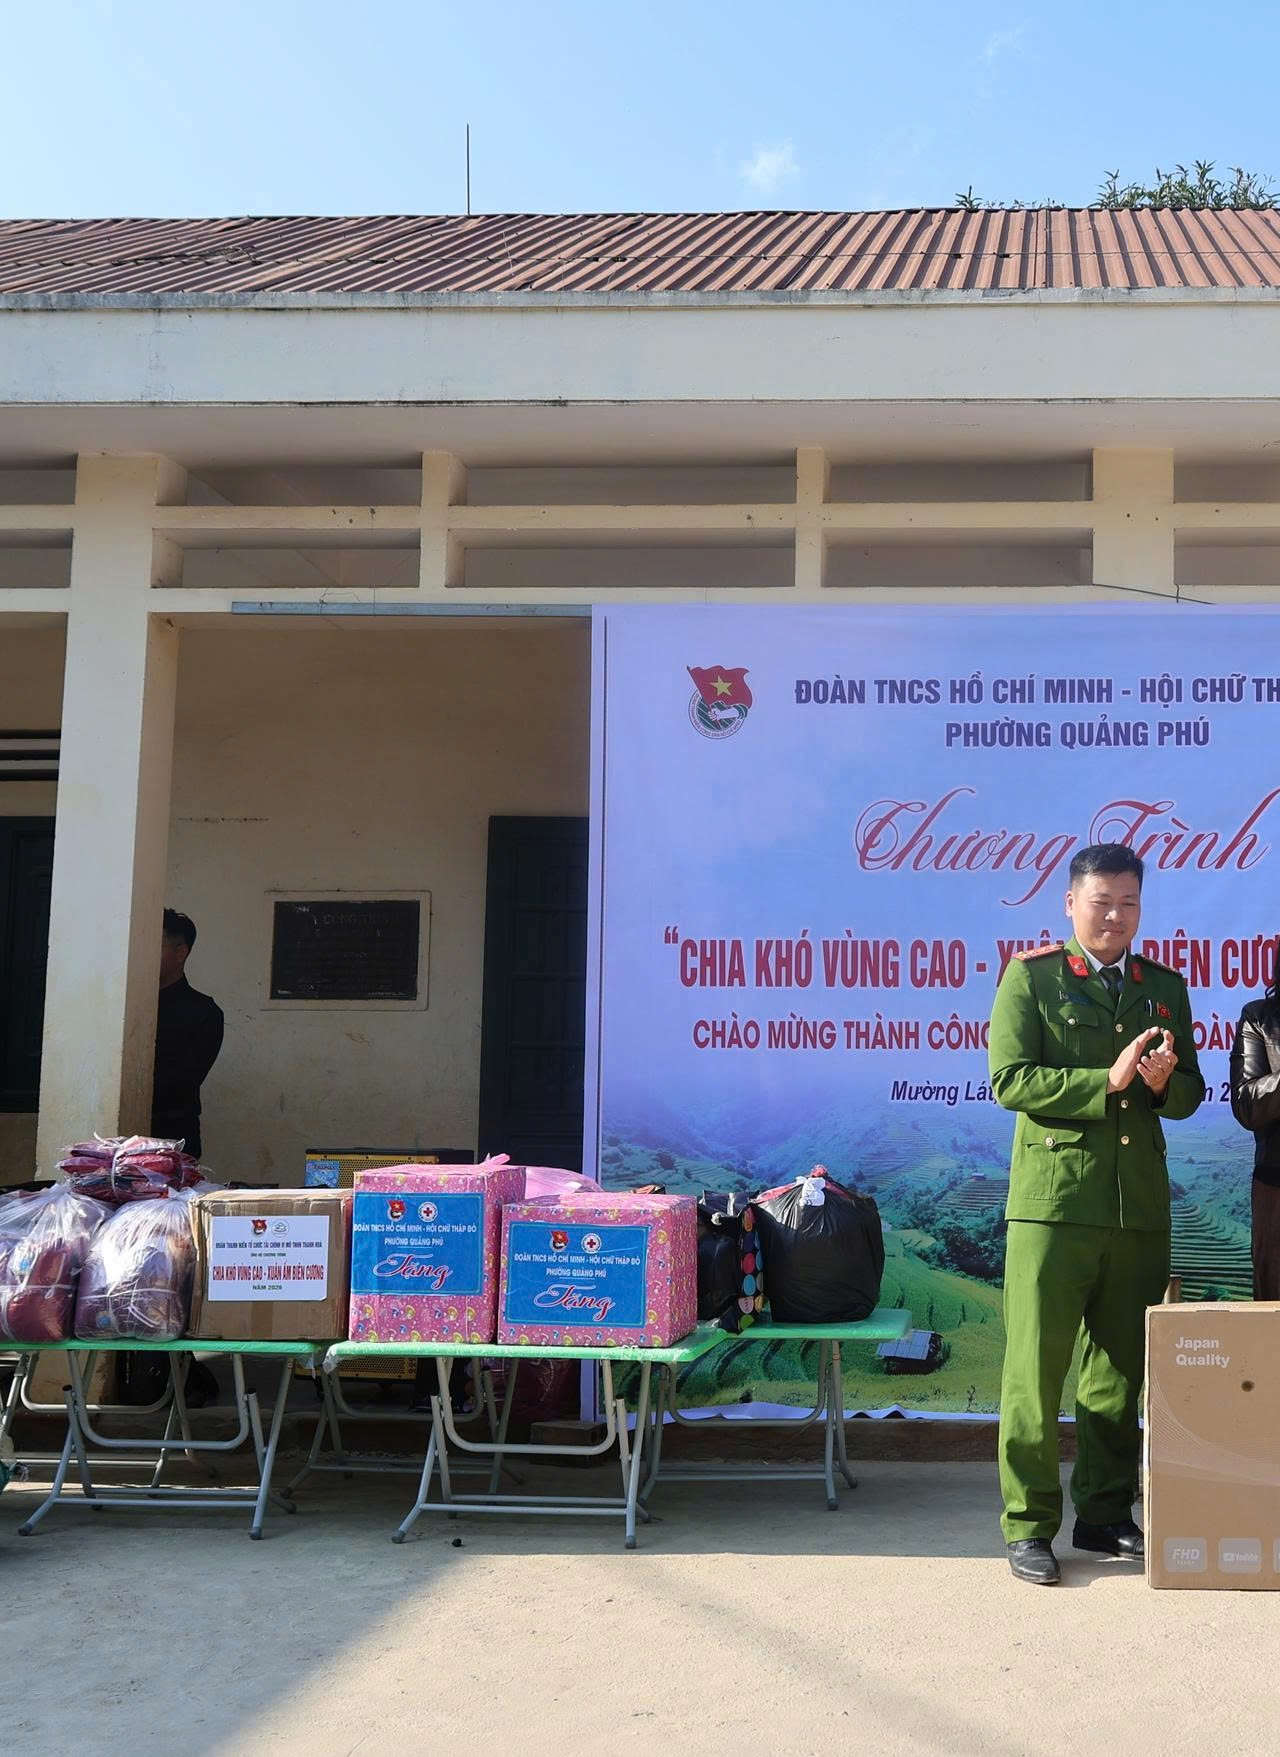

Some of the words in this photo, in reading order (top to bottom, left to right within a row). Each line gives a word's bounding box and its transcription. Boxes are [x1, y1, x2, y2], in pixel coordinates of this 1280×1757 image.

[794, 674, 866, 704] ĐOÀN
[873, 678, 941, 704] TNCS
[949, 671, 984, 704] HỒ
[992, 674, 1035, 704] CHÍ
[1044, 678, 1113, 704] MINH
[1140, 673, 1183, 709] HỘI
[1192, 673, 1247, 703] CHỮ
[945, 716, 1051, 748] PHƯỜNG
[1060, 713, 1149, 749] QUẢNG
[1157, 716, 1210, 747] PHÚ
[855, 787, 1078, 906] Chương
[755, 929, 813, 988] KHÓ
[822, 929, 900, 988] VÙNG
[910, 939, 966, 988] CAO
[693, 1011, 761, 1049] CHÀO
[767, 1011, 837, 1050] MỪNG
[843, 1012, 920, 1050] THÀNH
[891, 1080, 960, 1106] Mường
[373, 1253, 453, 1290] Tặng
[533, 1283, 616, 1322] Tặng
[1175, 1336, 1220, 1352] Japan
[1175, 1354, 1230, 1369] Quality
[1173, 1549, 1200, 1560] FHD
